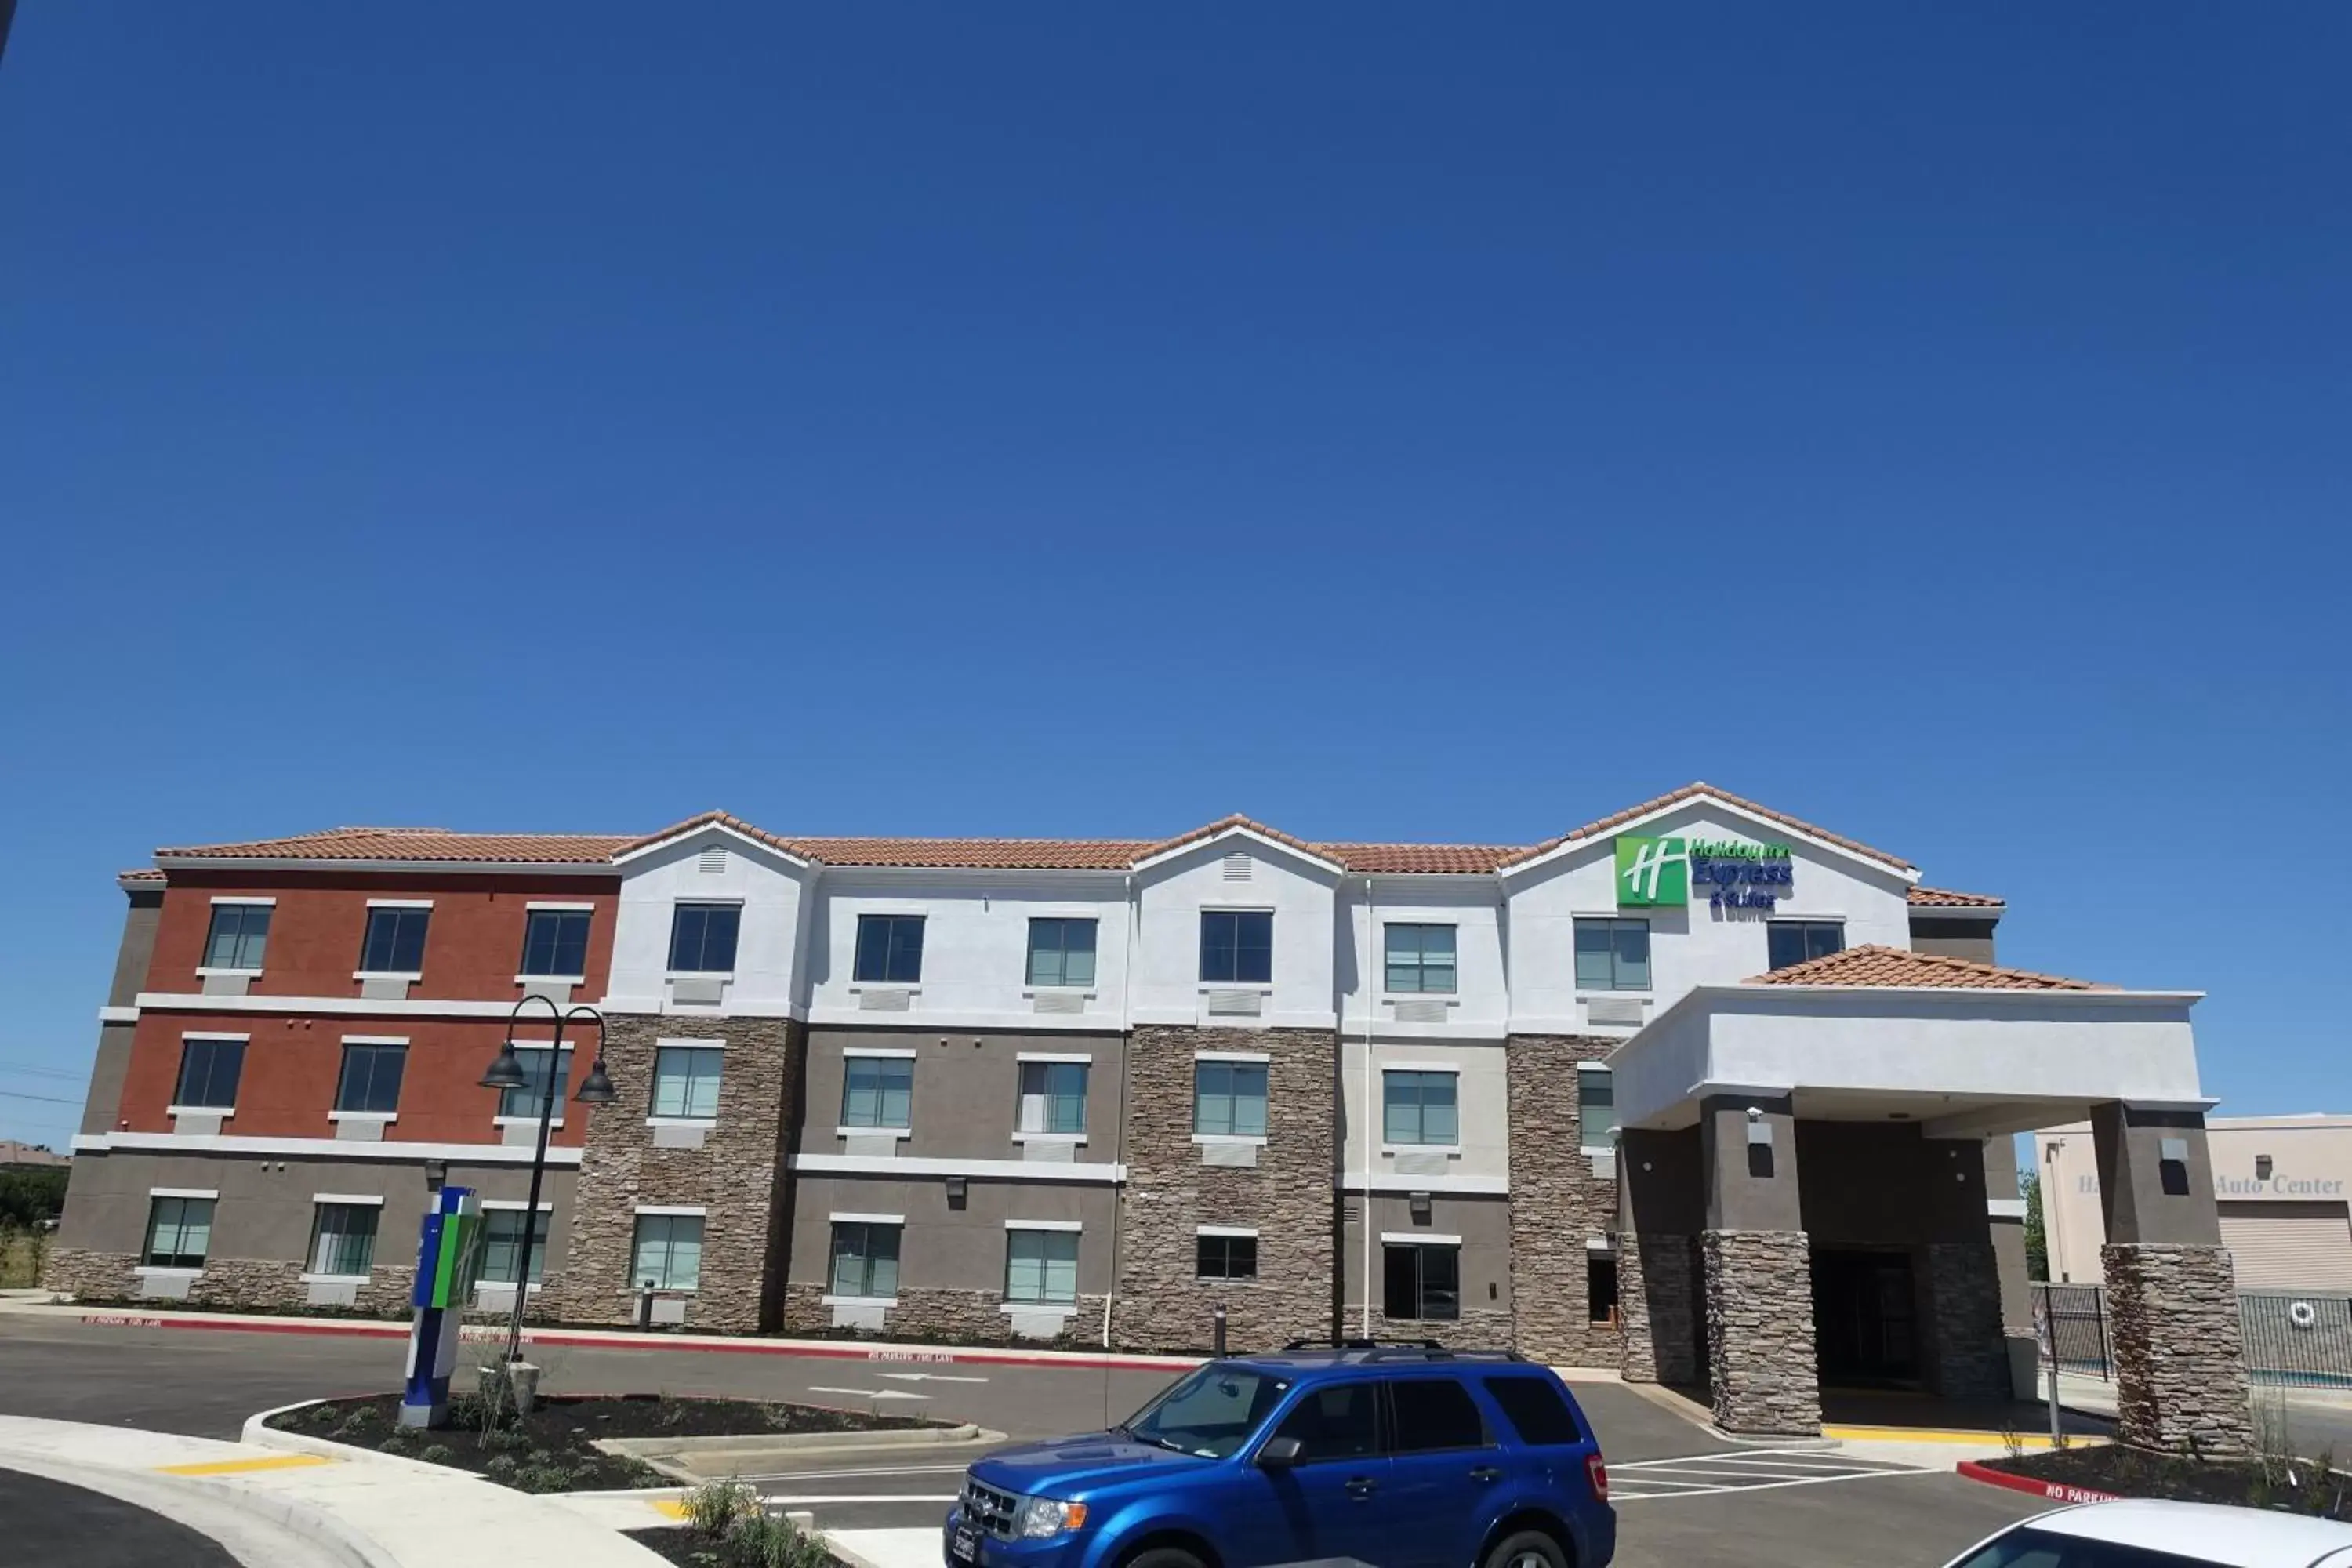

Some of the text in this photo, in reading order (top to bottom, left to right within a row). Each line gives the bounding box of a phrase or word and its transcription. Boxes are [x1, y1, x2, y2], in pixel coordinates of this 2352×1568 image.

[1690, 838, 1762, 862] Holiday
[1693, 859, 1793, 891] Express
[1725, 891, 1776, 909] Suites
[2216, 1175, 2343, 1195] Auto Center
[2045, 1485, 2063, 1498] NO
